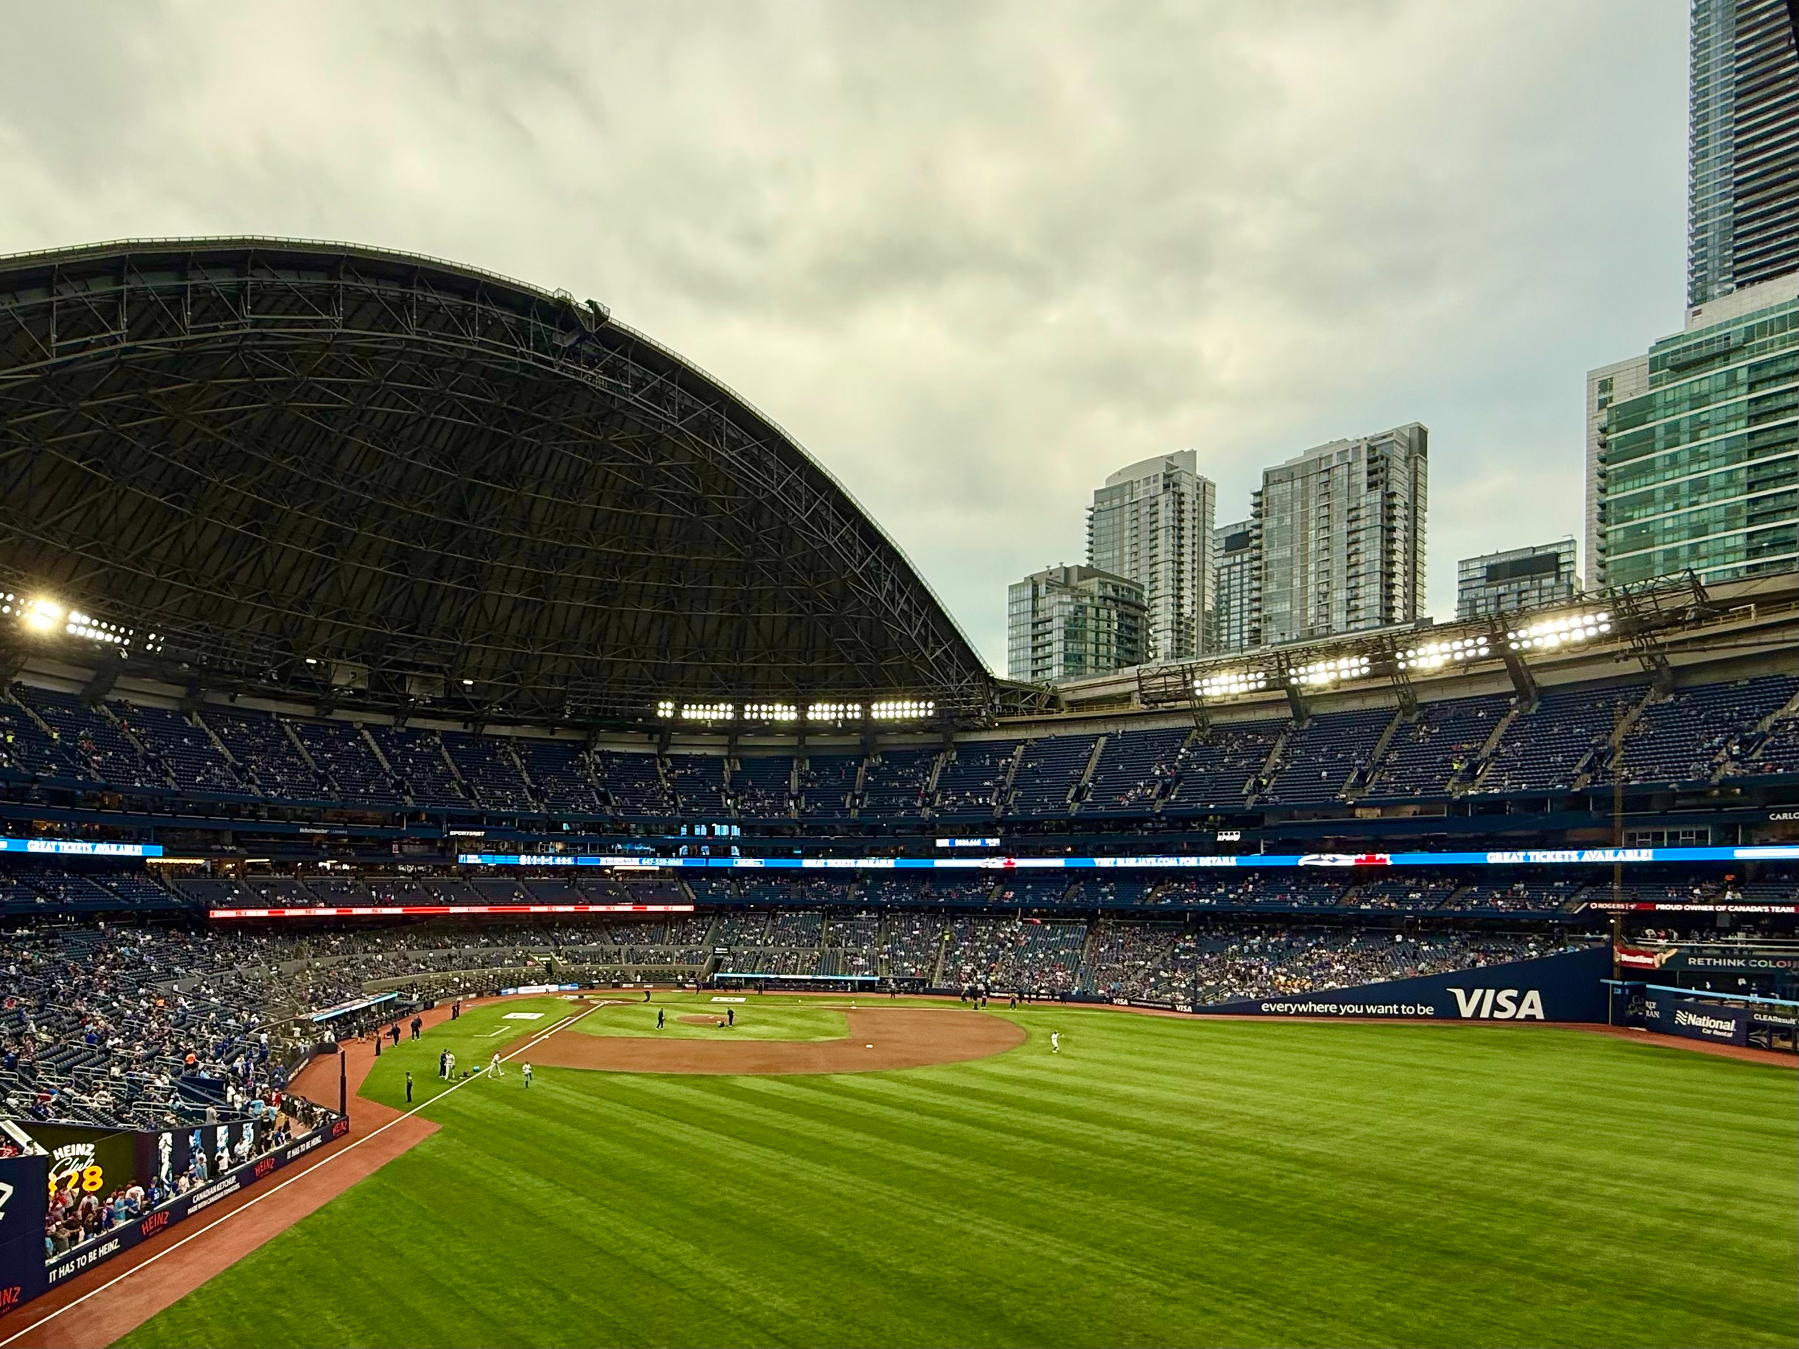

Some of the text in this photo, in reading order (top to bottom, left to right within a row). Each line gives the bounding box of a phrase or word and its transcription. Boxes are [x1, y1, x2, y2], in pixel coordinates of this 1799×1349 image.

[27, 840, 57, 851] GREAT
[1200, 856, 1237, 867] DETAILS
[1486, 848, 1653, 863] GREAT TICKETS AVAILABLE!
[1688, 958, 1746, 966] RETHINK
[1112, 998, 1128, 1006] VISA
[1175, 1004, 1192, 1012] VISA
[1261, 1001, 1434, 1016] everywhere you want to be
[1446, 988, 1545, 1020] VISA
[1688, 1014, 1737, 1032] National
[1712, 1028, 1733, 1038] Rental
[52, 1143, 95, 1160] HEINZ
[50, 1152, 95, 1180] Club
[254, 1158, 275, 1176] HEINZ
[192, 1184, 217, 1204] CANADIAN
[141, 1211, 170, 1236] HEINZ
[48, 1269, 58, 1284] IT
[58, 1260, 75, 1278] HAS
[76, 1256, 87, 1269] TO
[88, 1250, 98, 1262] BE
